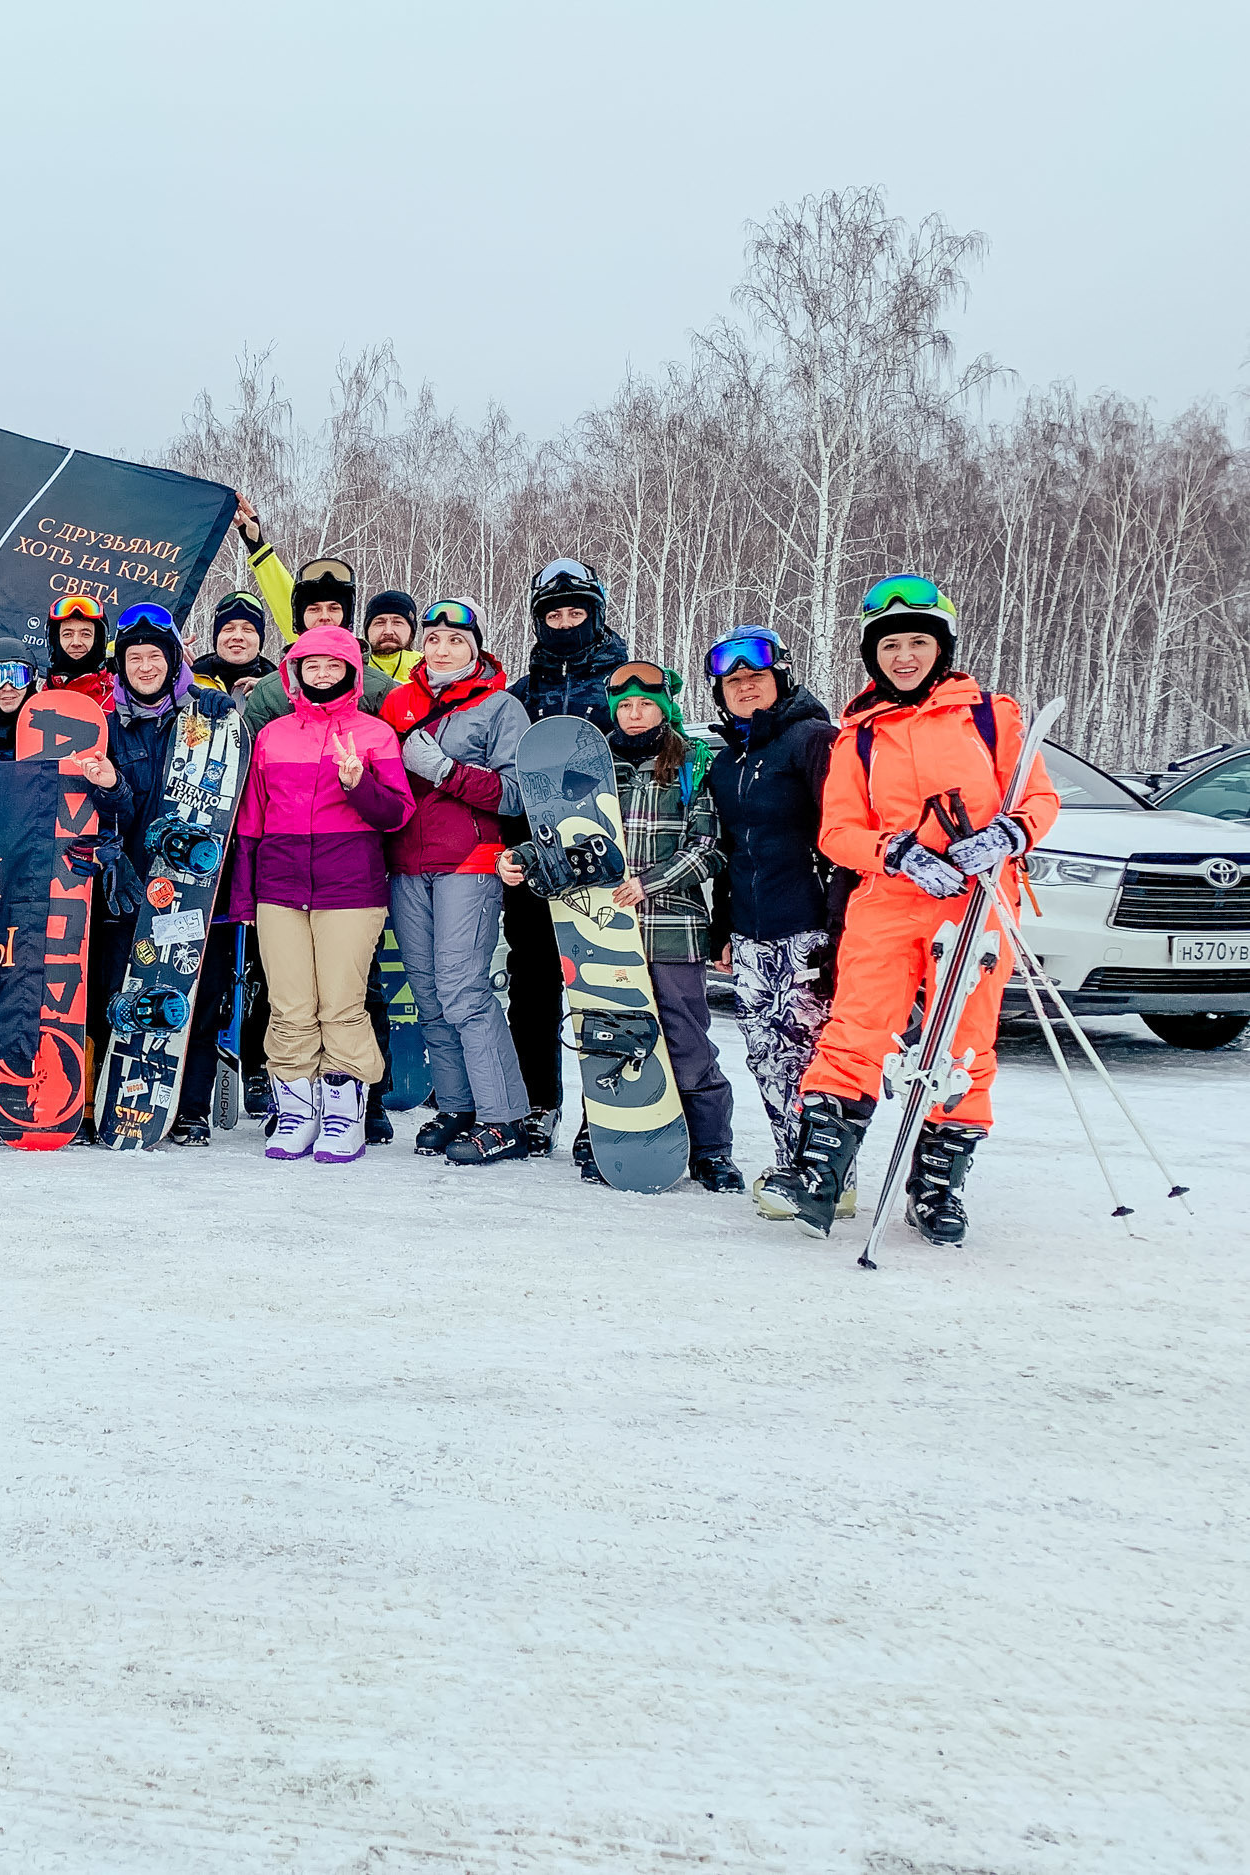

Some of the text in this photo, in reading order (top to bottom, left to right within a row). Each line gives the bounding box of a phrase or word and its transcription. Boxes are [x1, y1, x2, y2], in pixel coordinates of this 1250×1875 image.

[38, 517, 182, 564] С ДРУЗЬЯМИ
[13, 536, 181, 592] ХОТЬ НА КРАЙ
[49, 573, 120, 606] СВЕТА
[168, 777, 220, 807] LISTEN TO
[170, 788, 210, 812] LEMMY
[135, 940, 157, 965] NITRO
[220, 1069, 230, 1126] AMBITION
[114, 1104, 154, 1124] HILLS
